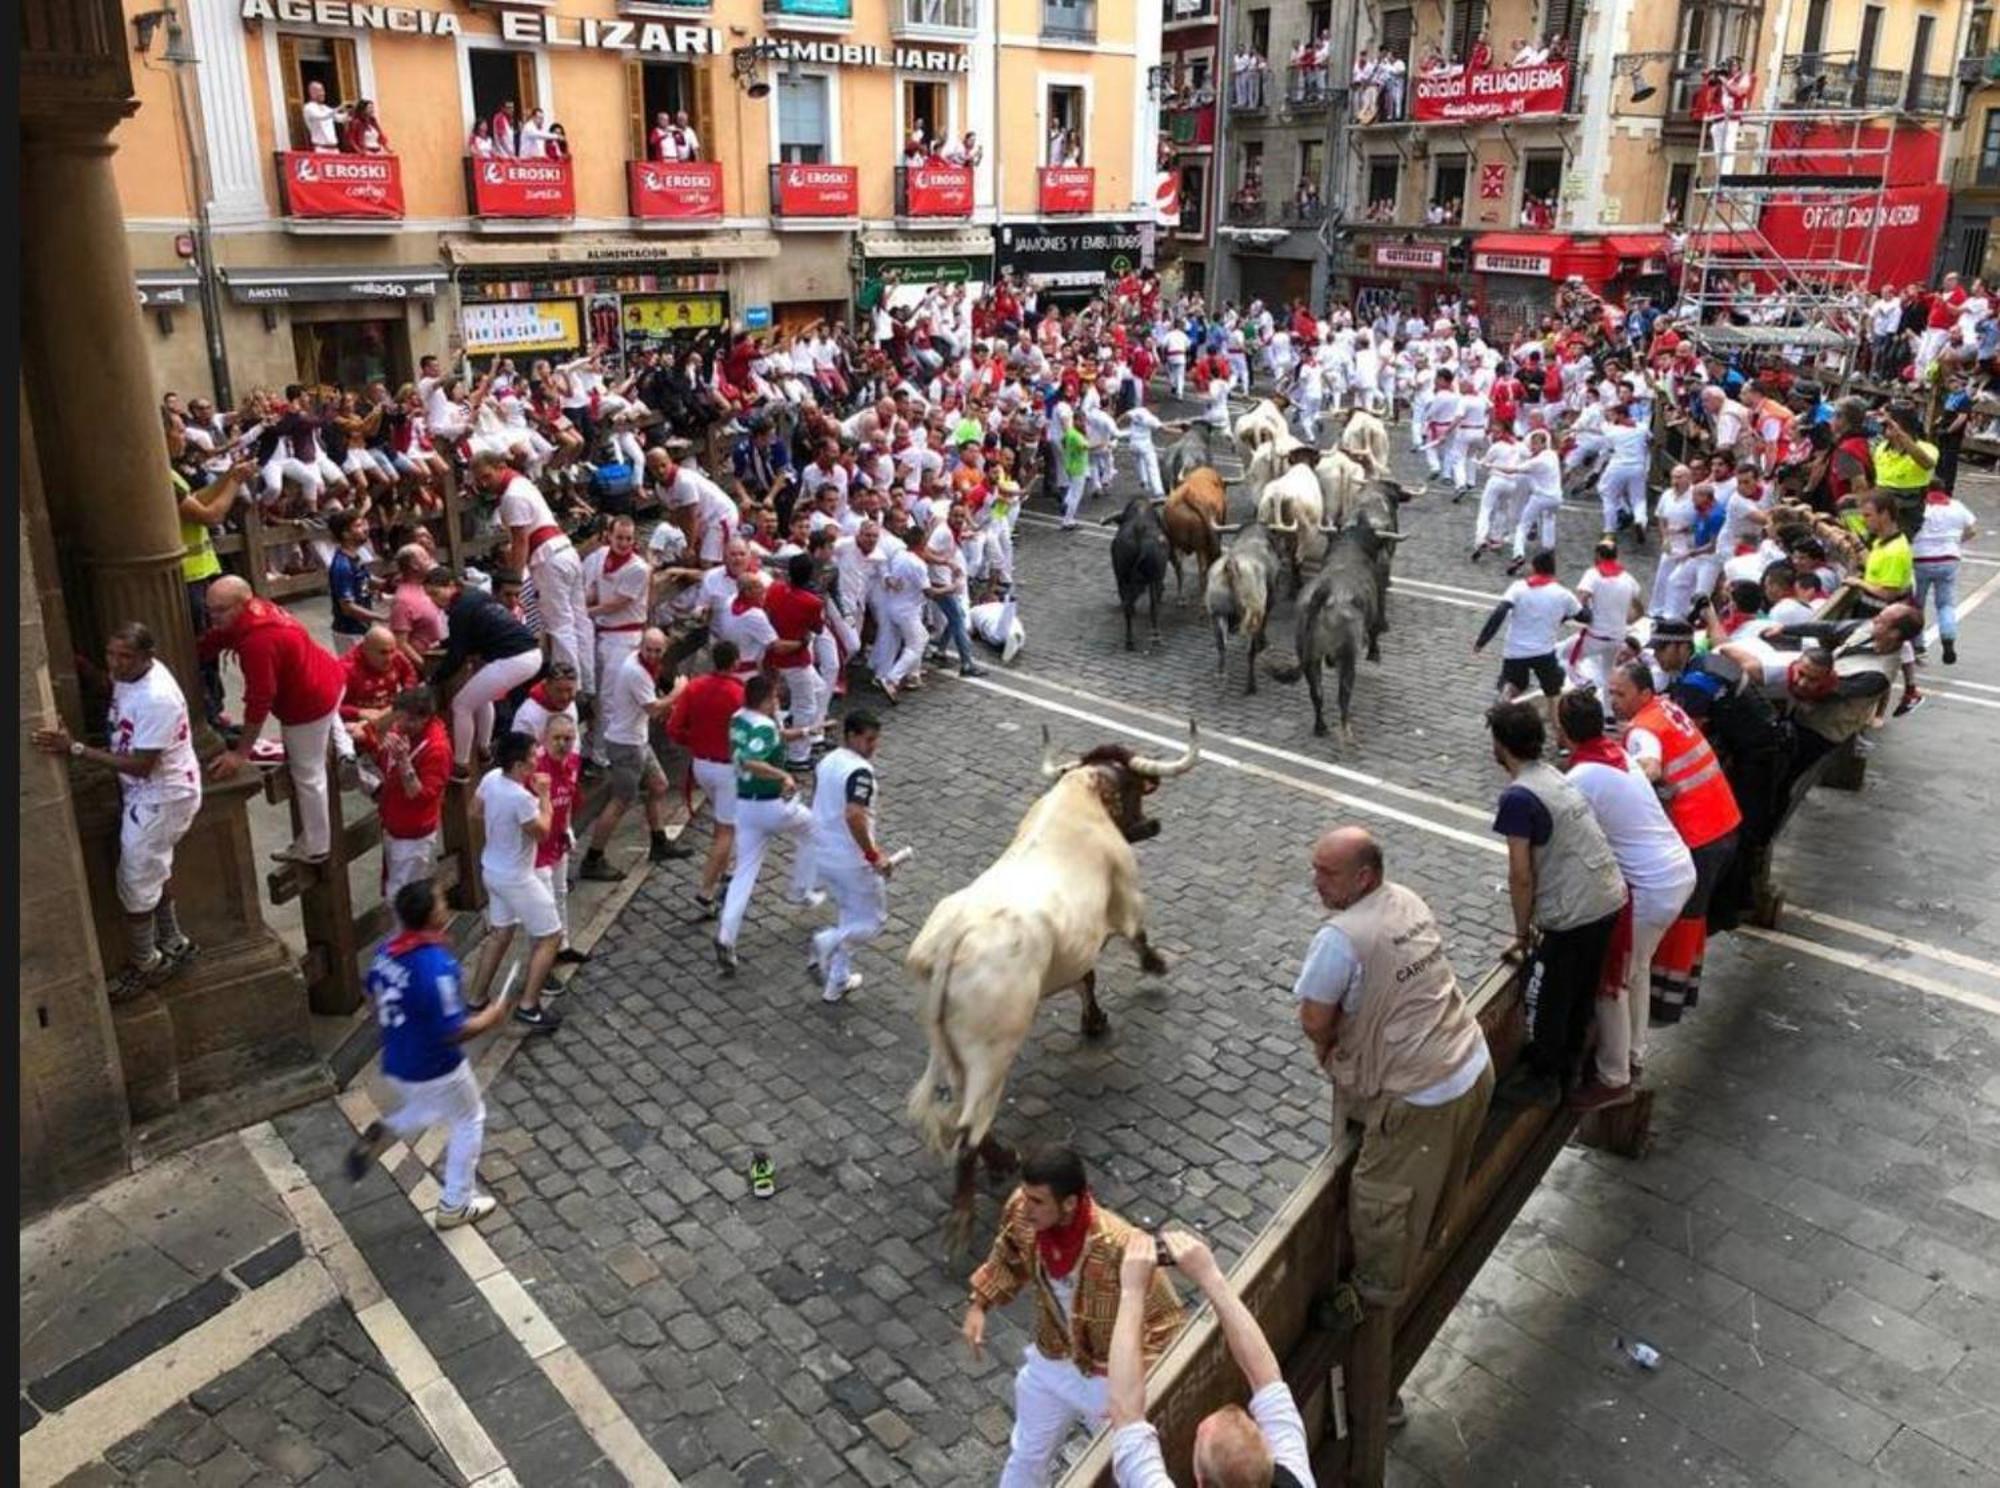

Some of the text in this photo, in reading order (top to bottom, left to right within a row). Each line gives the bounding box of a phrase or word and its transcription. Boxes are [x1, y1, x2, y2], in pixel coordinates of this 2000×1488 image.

[242, 0, 462, 35] AGENCIA
[502, 11, 723, 55] ELIZARI
[324, 163, 387, 179] EROSKI
[508, 167, 561, 181] EROSKI
[807, 171, 848, 184] EROSKI
[664, 175, 711, 188] EROSKI
[930, 174, 967, 185] EROSKI
[1014, 236, 1067, 253] JAMONES
[1070, 235, 1080, 250] Y
